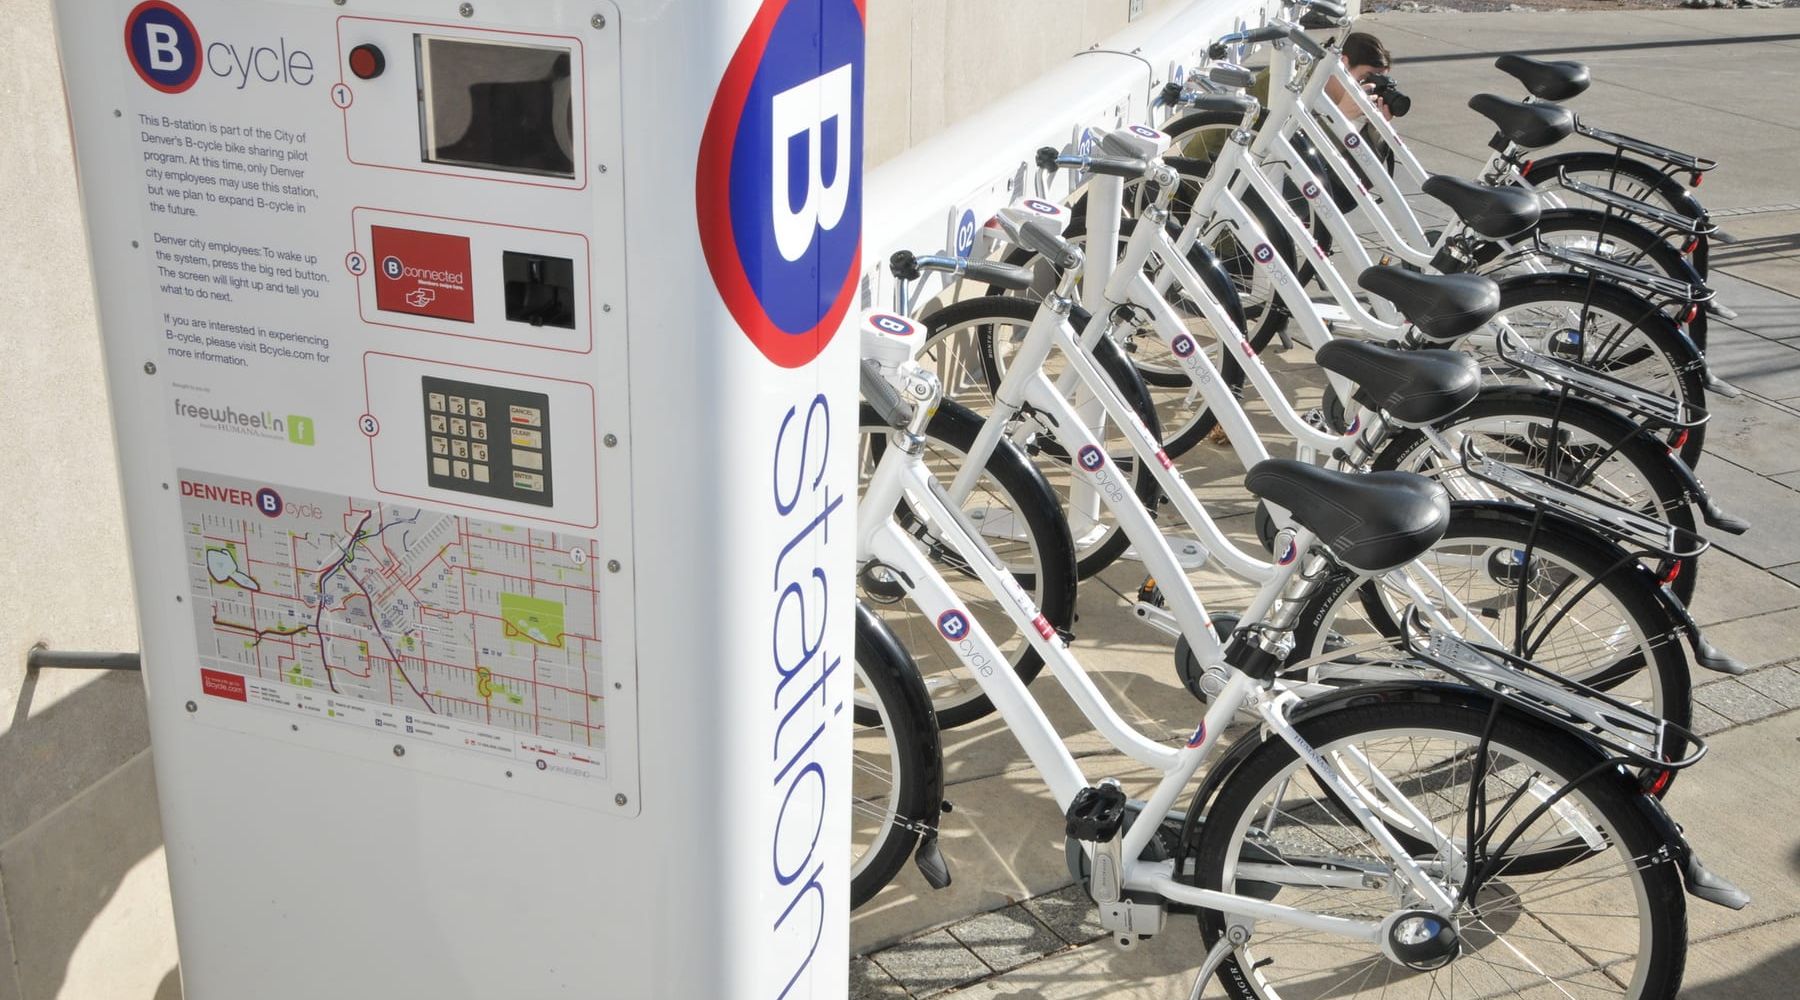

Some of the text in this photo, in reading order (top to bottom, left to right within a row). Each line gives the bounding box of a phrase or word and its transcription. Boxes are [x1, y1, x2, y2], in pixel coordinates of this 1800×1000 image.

[146, 23, 314, 90] B cycle
[337, 89, 345, 103] 1
[138, 114, 306, 144] This B-station is part of the City of
[141, 131, 308, 162] Denver's B-cycle bike sharing pilot
[144, 152, 304, 178] program. At this time, only Denver
[146, 167, 318, 198] city employees may use this station,
[1306, 184, 1317, 196] B
[147, 184, 306, 212] but we plan to expand B-cycle in
[150, 201, 198, 216] the future.
[958, 221, 974, 252] 02
[154, 232, 317, 266] Denver city employees: To wake up
[1257, 247, 1270, 260] B
[156, 250, 329, 282] the system, press the big red button.
[351, 256, 361, 271] 2
[388, 261, 463, 284] B connected
[158, 266, 319, 298] The screen will light up and tell you
[160, 284, 232, 302] what to do next.
[164, 313, 329, 349] If you are interested in experiencing
[879, 317, 905, 332] B
[166, 329, 330, 363] B-cycle, please visit Bcycle.com for
[168, 348, 248, 367] more information.
[1176, 338, 1211, 385] B cycle
[511, 407, 533, 416] CANCEL
[365, 418, 374, 432] 3
[438, 422, 445, 432] 4
[458, 425, 465, 435] 5
[479, 428, 485, 439] 6
[440, 443, 446, 453] 7
[460, 447, 466, 457] 8
[480, 450, 486, 460] 9
[461, 468, 467, 478] 0
[514, 472, 533, 480] ENTER
[1083, 450, 1123, 503] B cycle
[181, 480, 323, 519] DENVER B cycle
[771, 63, 852, 1000] B station
[1312, 576, 1352, 628] BONTRAGER
[943, 615, 994, 678] B cycle
